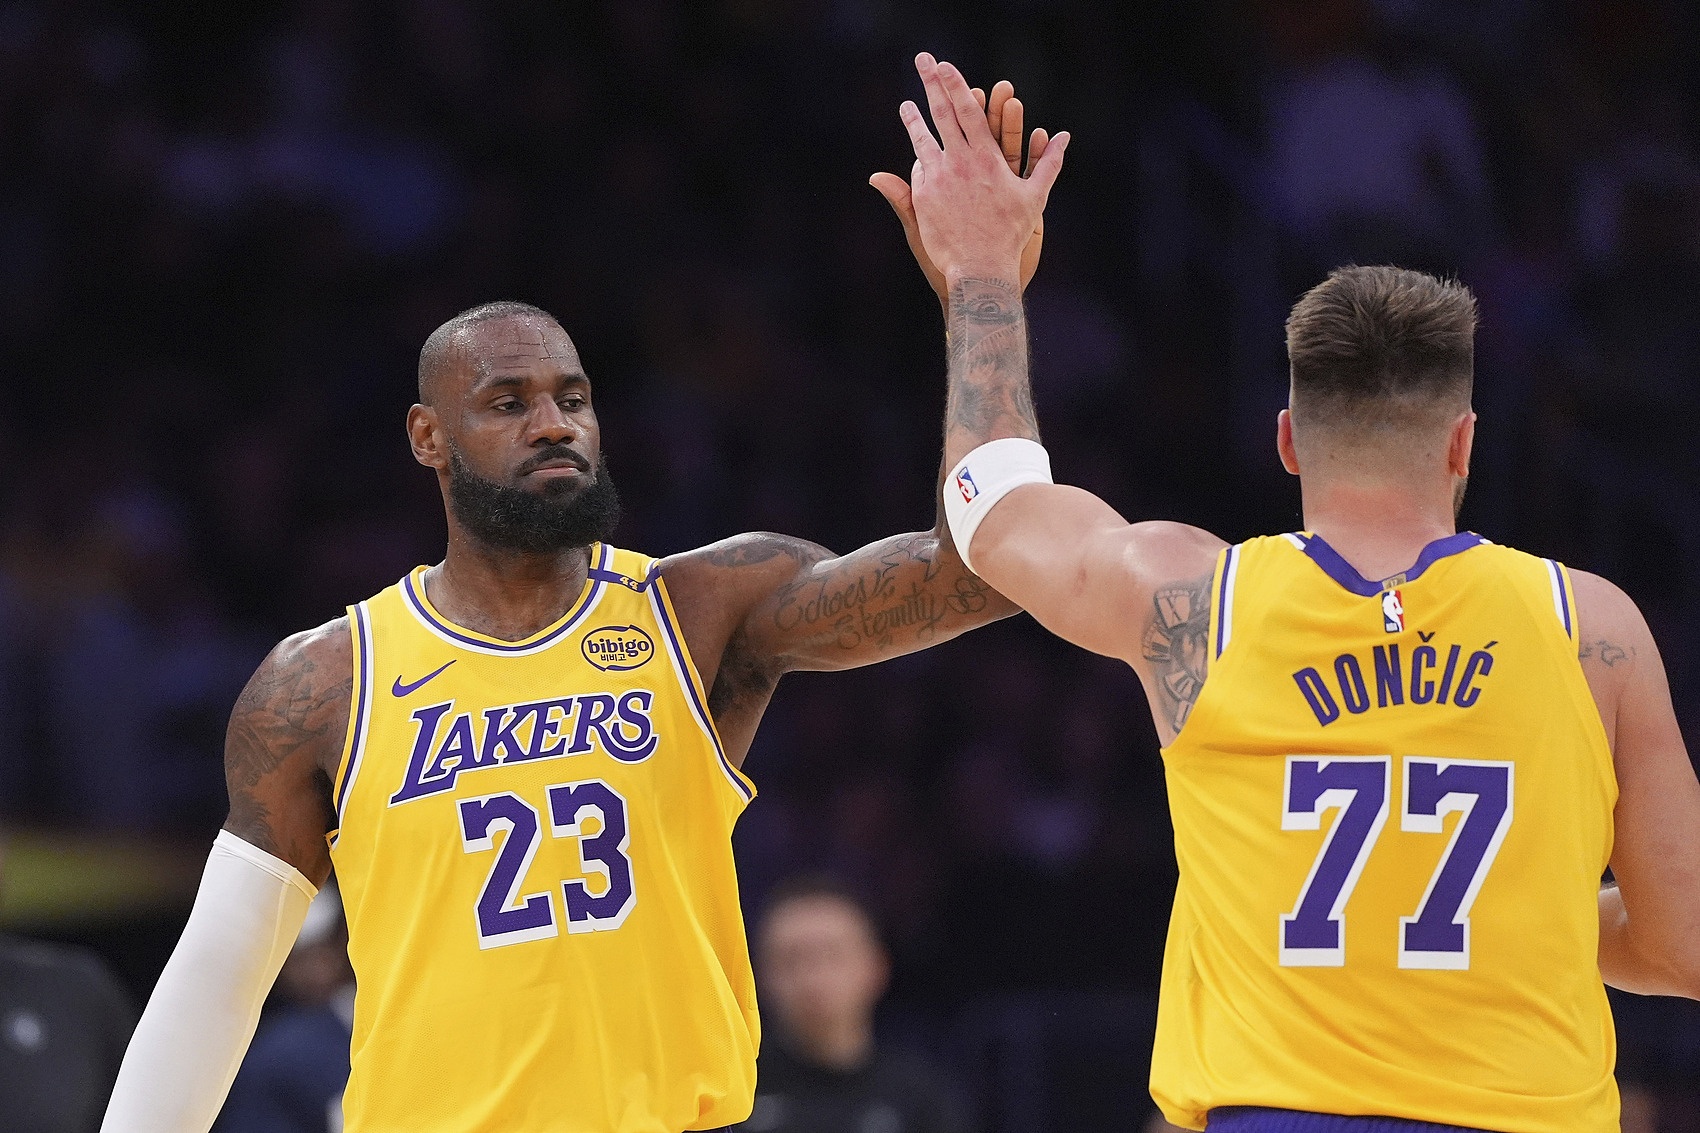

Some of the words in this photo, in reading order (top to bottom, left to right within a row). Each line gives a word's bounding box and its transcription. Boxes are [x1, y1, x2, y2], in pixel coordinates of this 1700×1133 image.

[619, 576, 639, 590] 44
[587, 637, 650, 658] bibigo
[600, 653, 627, 663] 비비고
[1292, 631, 1498, 727] DONČIĆ
[387, 689, 659, 809] LAKERS
[455, 778, 638, 950] 23
[1278, 754, 1515, 971] 77
